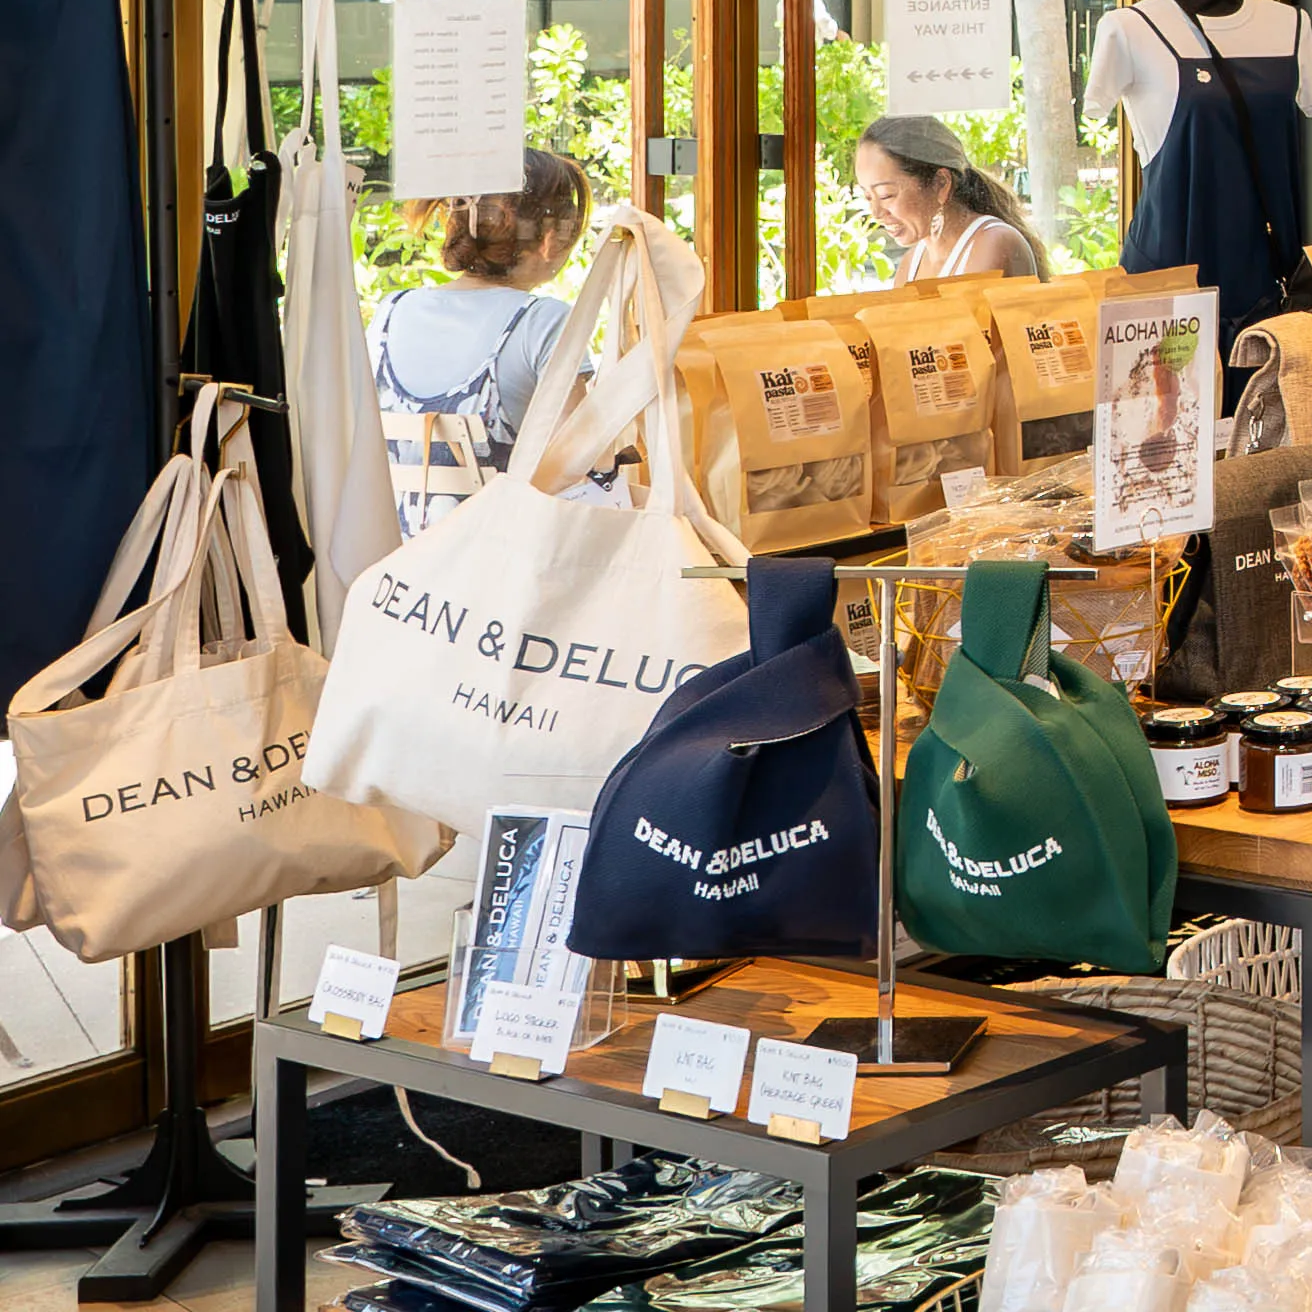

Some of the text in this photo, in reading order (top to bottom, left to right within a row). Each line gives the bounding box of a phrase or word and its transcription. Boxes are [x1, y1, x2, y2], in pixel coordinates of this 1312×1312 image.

[1024, 321, 1052, 343] Kai
[1103, 316, 1202, 345] ALOHA MISO
[907, 344, 937, 368] Kai
[1029, 339, 1054, 354] pasta
[759, 367, 795, 391] Kai
[911, 362, 938, 379] pasta
[763, 384, 796, 403] pasta
[1235, 548, 1272, 572] DEAN
[846, 597, 872, 622] Kai
[371, 571, 711, 696] DEAN & DELUC
[451, 680, 561, 734] HAWAII
[1193, 758, 1221, 771] ALOHA
[1196, 767, 1218, 779] MISO
[80, 755, 261, 824] DEAN &
[633, 816, 830, 875] DEAN & DELUCA
[963, 836, 1064, 879] DELUCA
[489, 827, 519, 927] DELUCA
[693, 872, 760, 901] HAWAII
[548, 858, 575, 928] DELUCA
[507, 898, 525, 949] HAWAII
[486, 931, 502, 948] &
[546, 934, 558, 944] &
